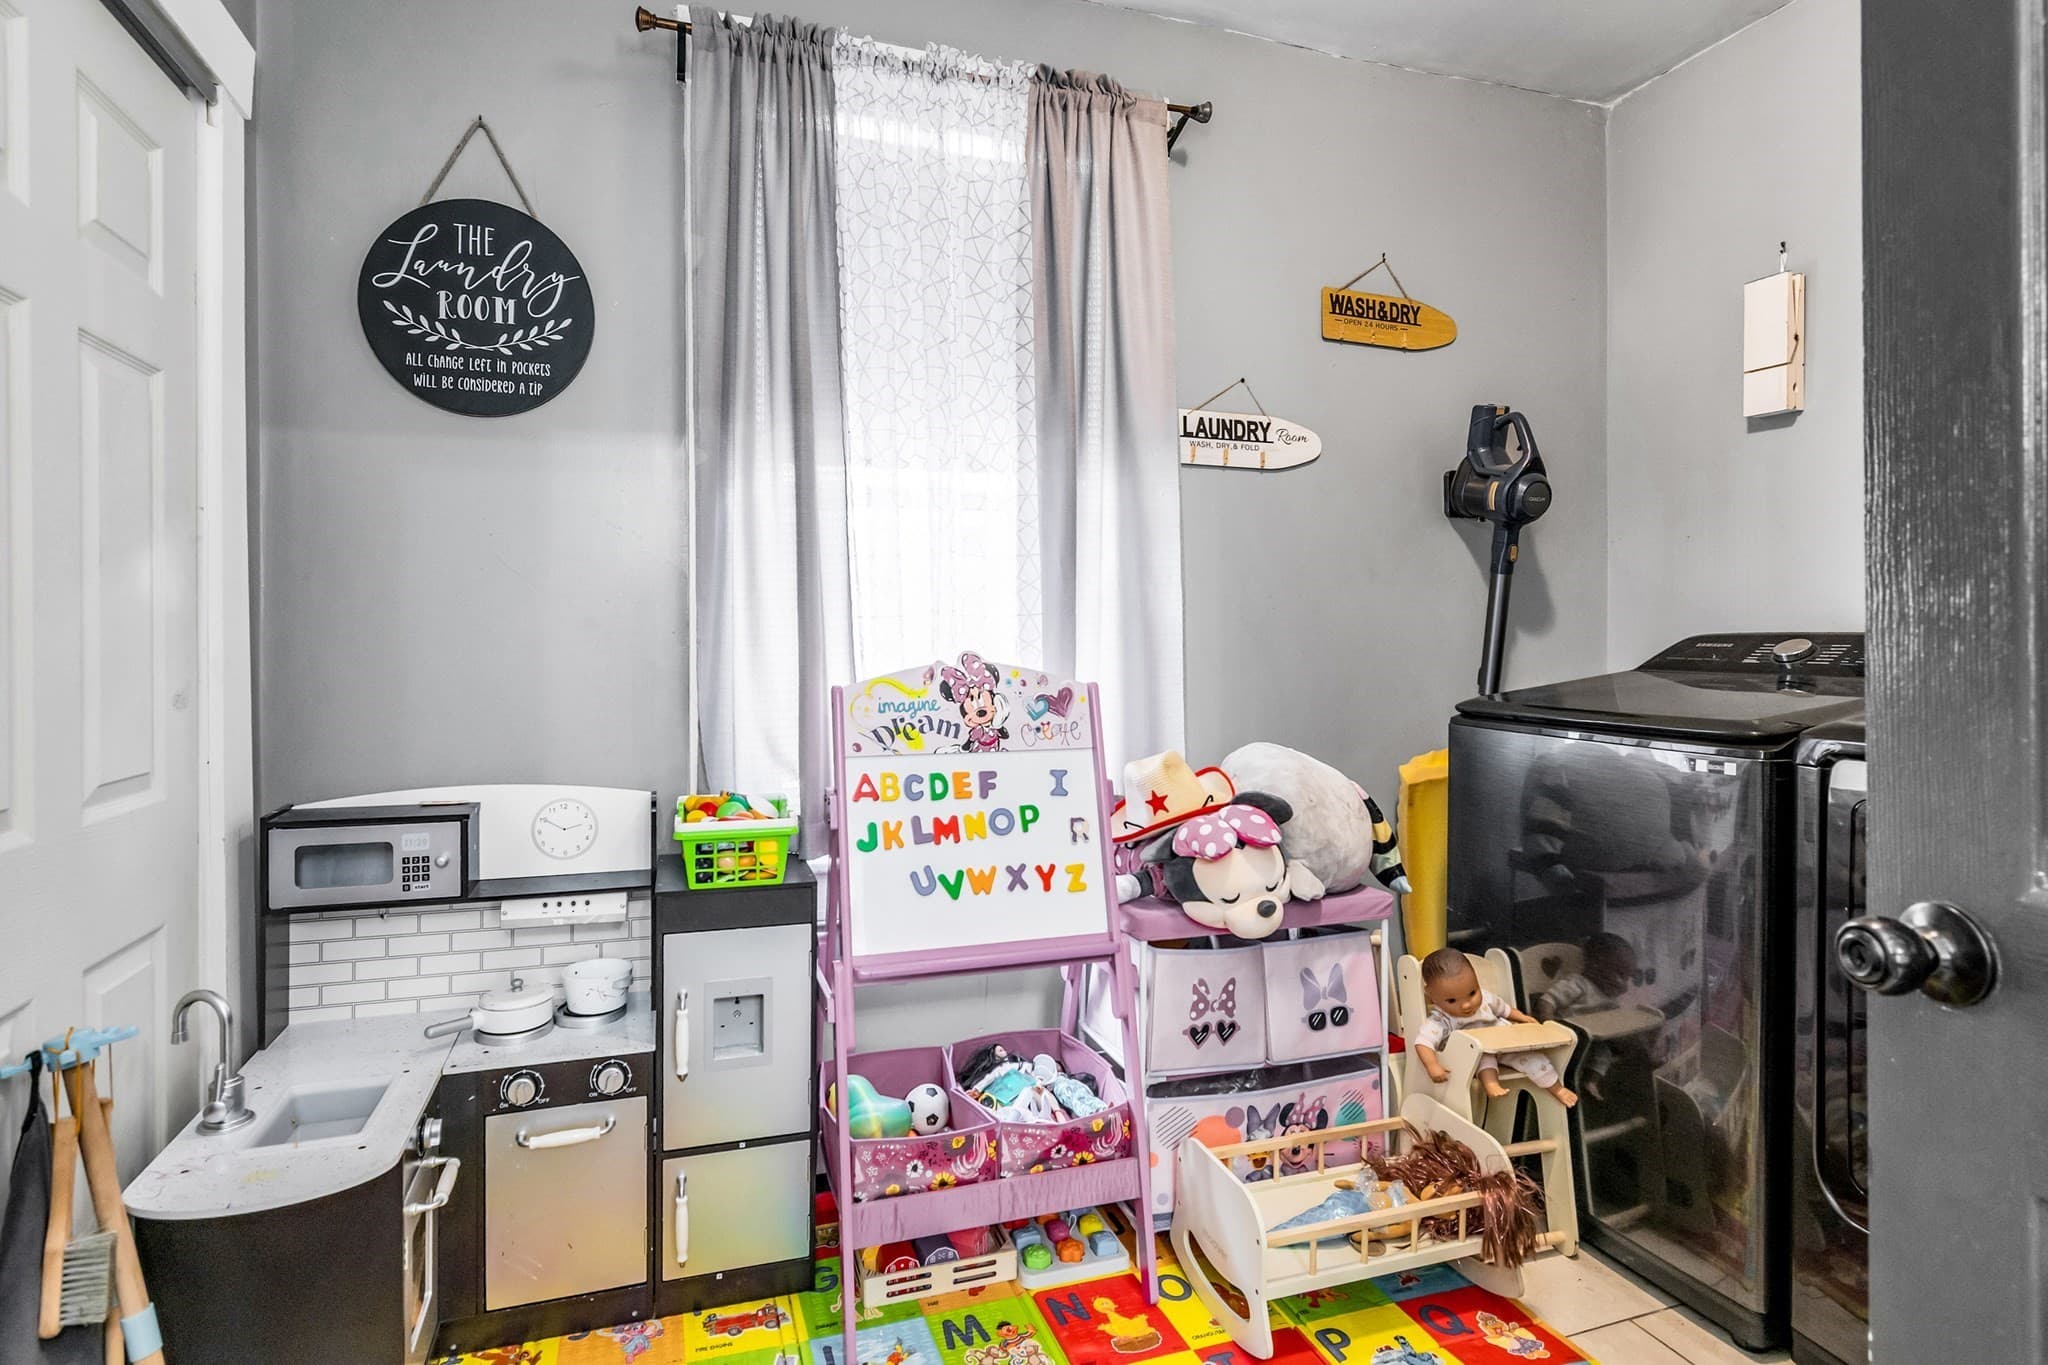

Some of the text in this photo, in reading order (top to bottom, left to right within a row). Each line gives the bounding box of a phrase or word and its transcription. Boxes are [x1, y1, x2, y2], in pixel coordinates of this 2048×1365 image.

[453, 223, 495, 256] THE
[372, 223, 581, 318] Laundry
[436, 290, 517, 325] ROOM
[1329, 293, 1421, 325] WASH&DRY
[1343, 318, 1362, 326] OPEN
[1375, 322, 1399, 331] HOURS
[405, 352, 424, 367] ALL
[519, 382, 525, 395] A
[1182, 415, 1310, 445] LAUNDRY Room
[1241, 443, 1260, 452] FOLD
[877, 695, 941, 719] imagine
[871, 715, 961, 751] Dream
[1049, 769, 1069, 797] I
[1158, 1273, 1193, 1301] O
[1045, 1292, 1092, 1326] N
[1418, 1304, 1475, 1336] Q
[942, 1314, 992, 1350] M
[1314, 1327, 1351, 1364] P
